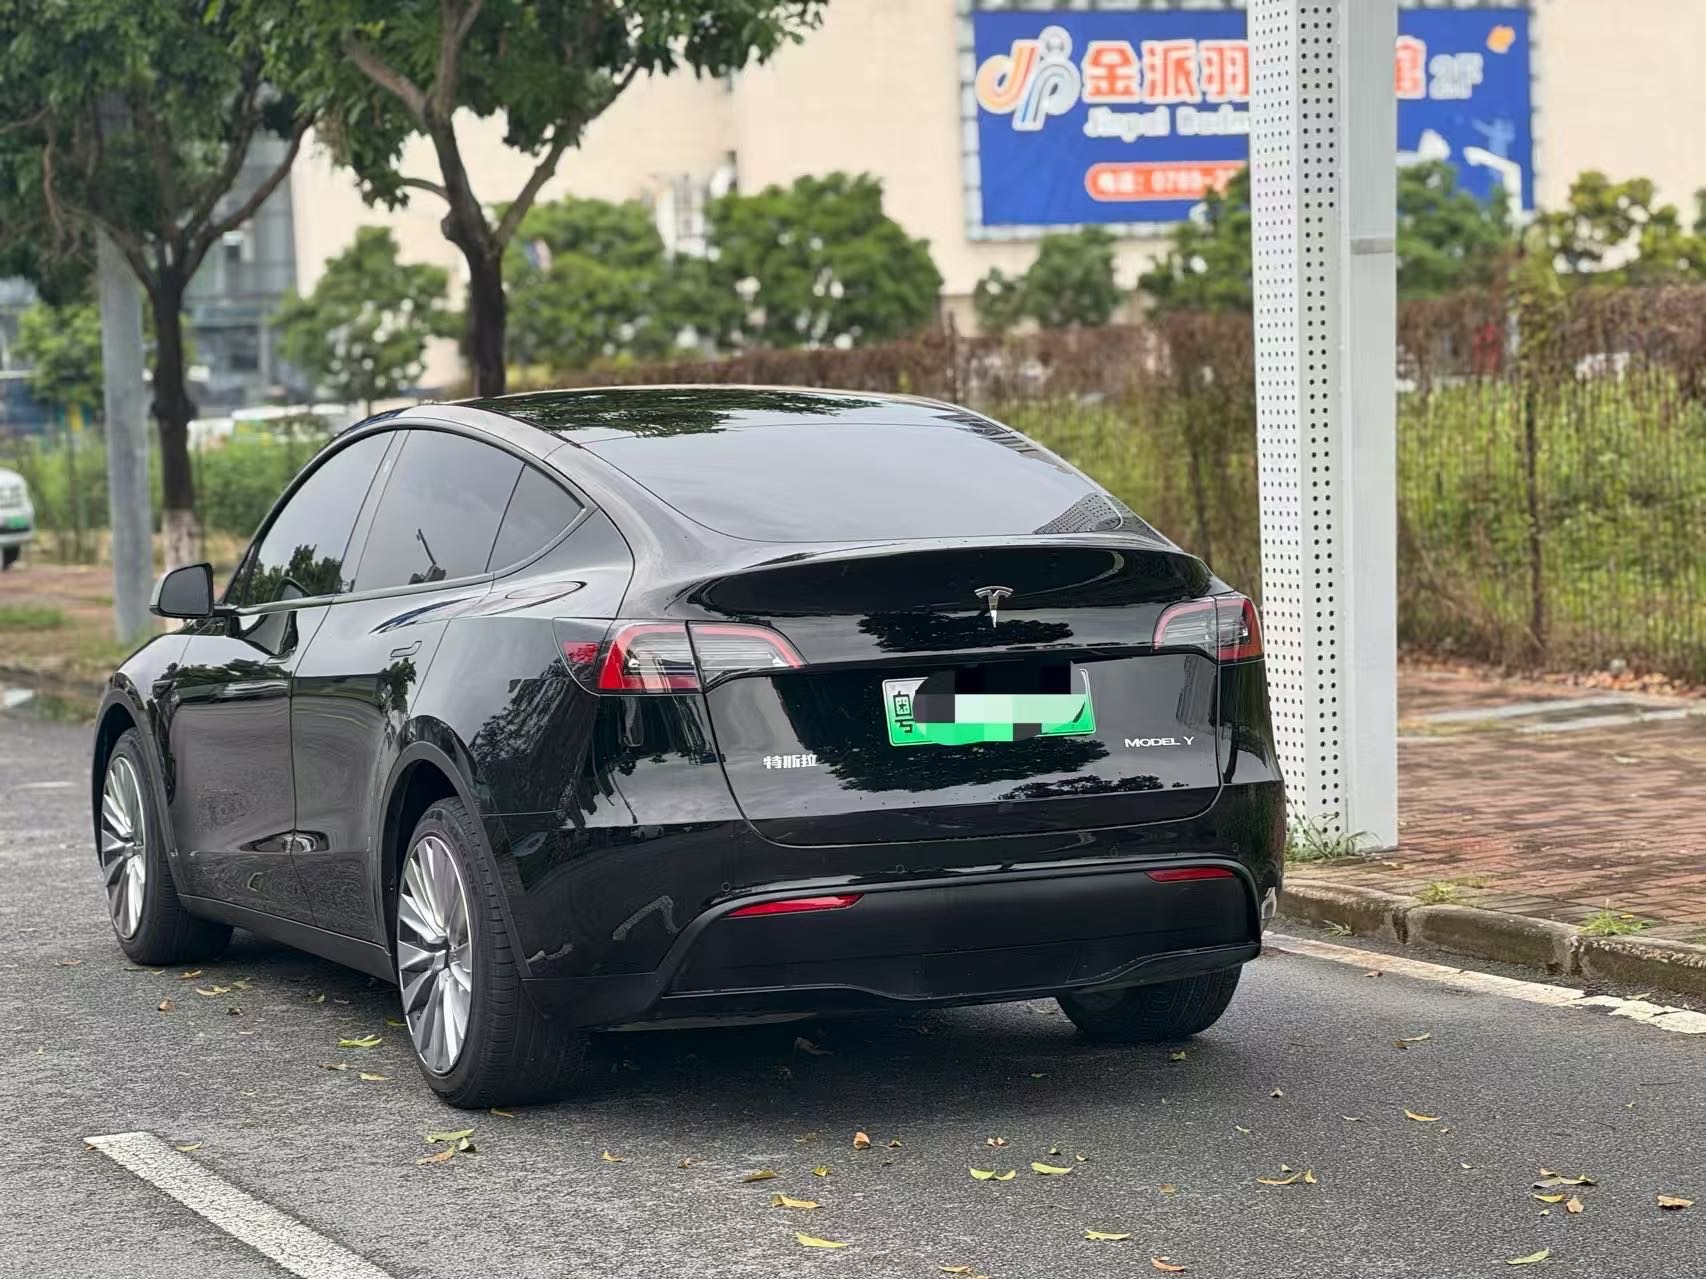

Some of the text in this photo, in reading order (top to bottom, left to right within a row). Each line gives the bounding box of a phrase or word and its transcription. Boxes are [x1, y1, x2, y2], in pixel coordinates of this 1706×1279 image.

[1124, 735, 1195, 748] MODEL Y
[763, 753, 818, 770] 特斯拉
